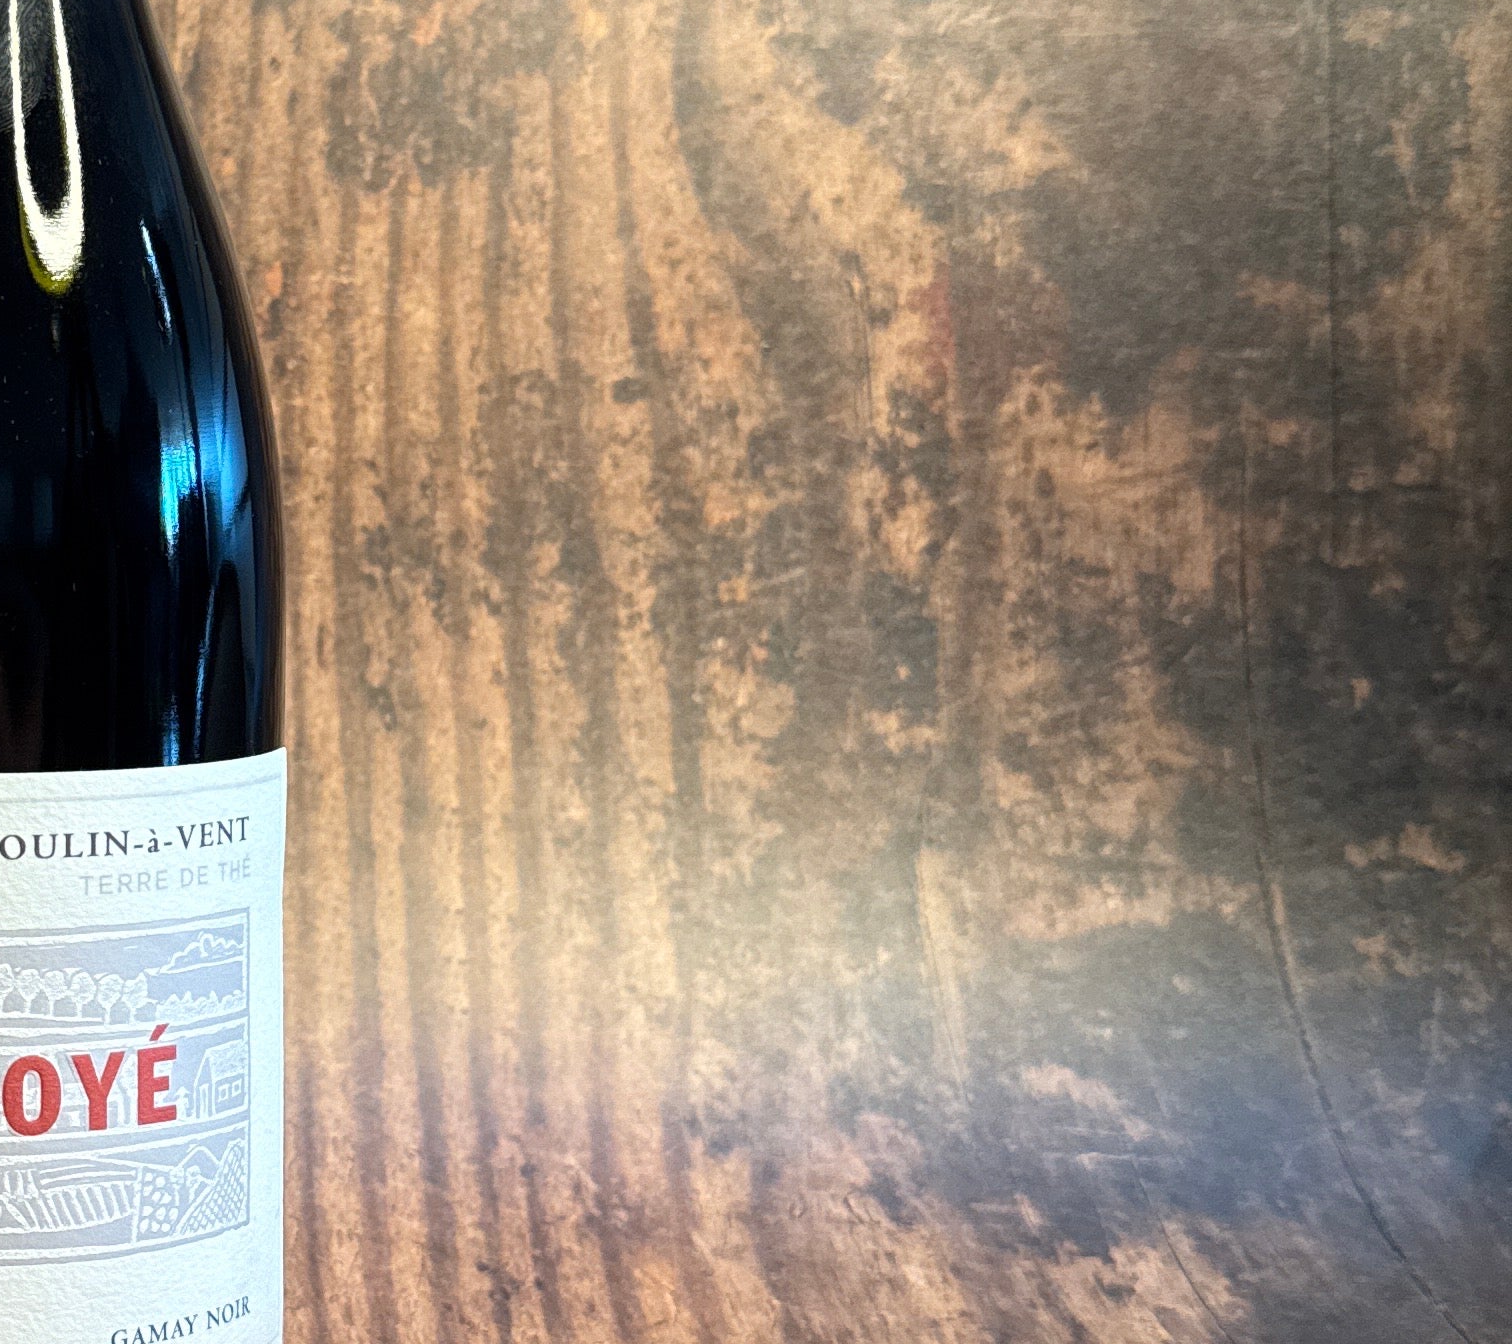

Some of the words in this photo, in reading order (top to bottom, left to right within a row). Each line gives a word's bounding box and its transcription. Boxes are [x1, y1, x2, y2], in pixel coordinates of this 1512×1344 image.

[79, 868, 169, 898] TERRE
[180, 864, 210, 888] DE
[206, 1295, 251, 1330] NOIR
